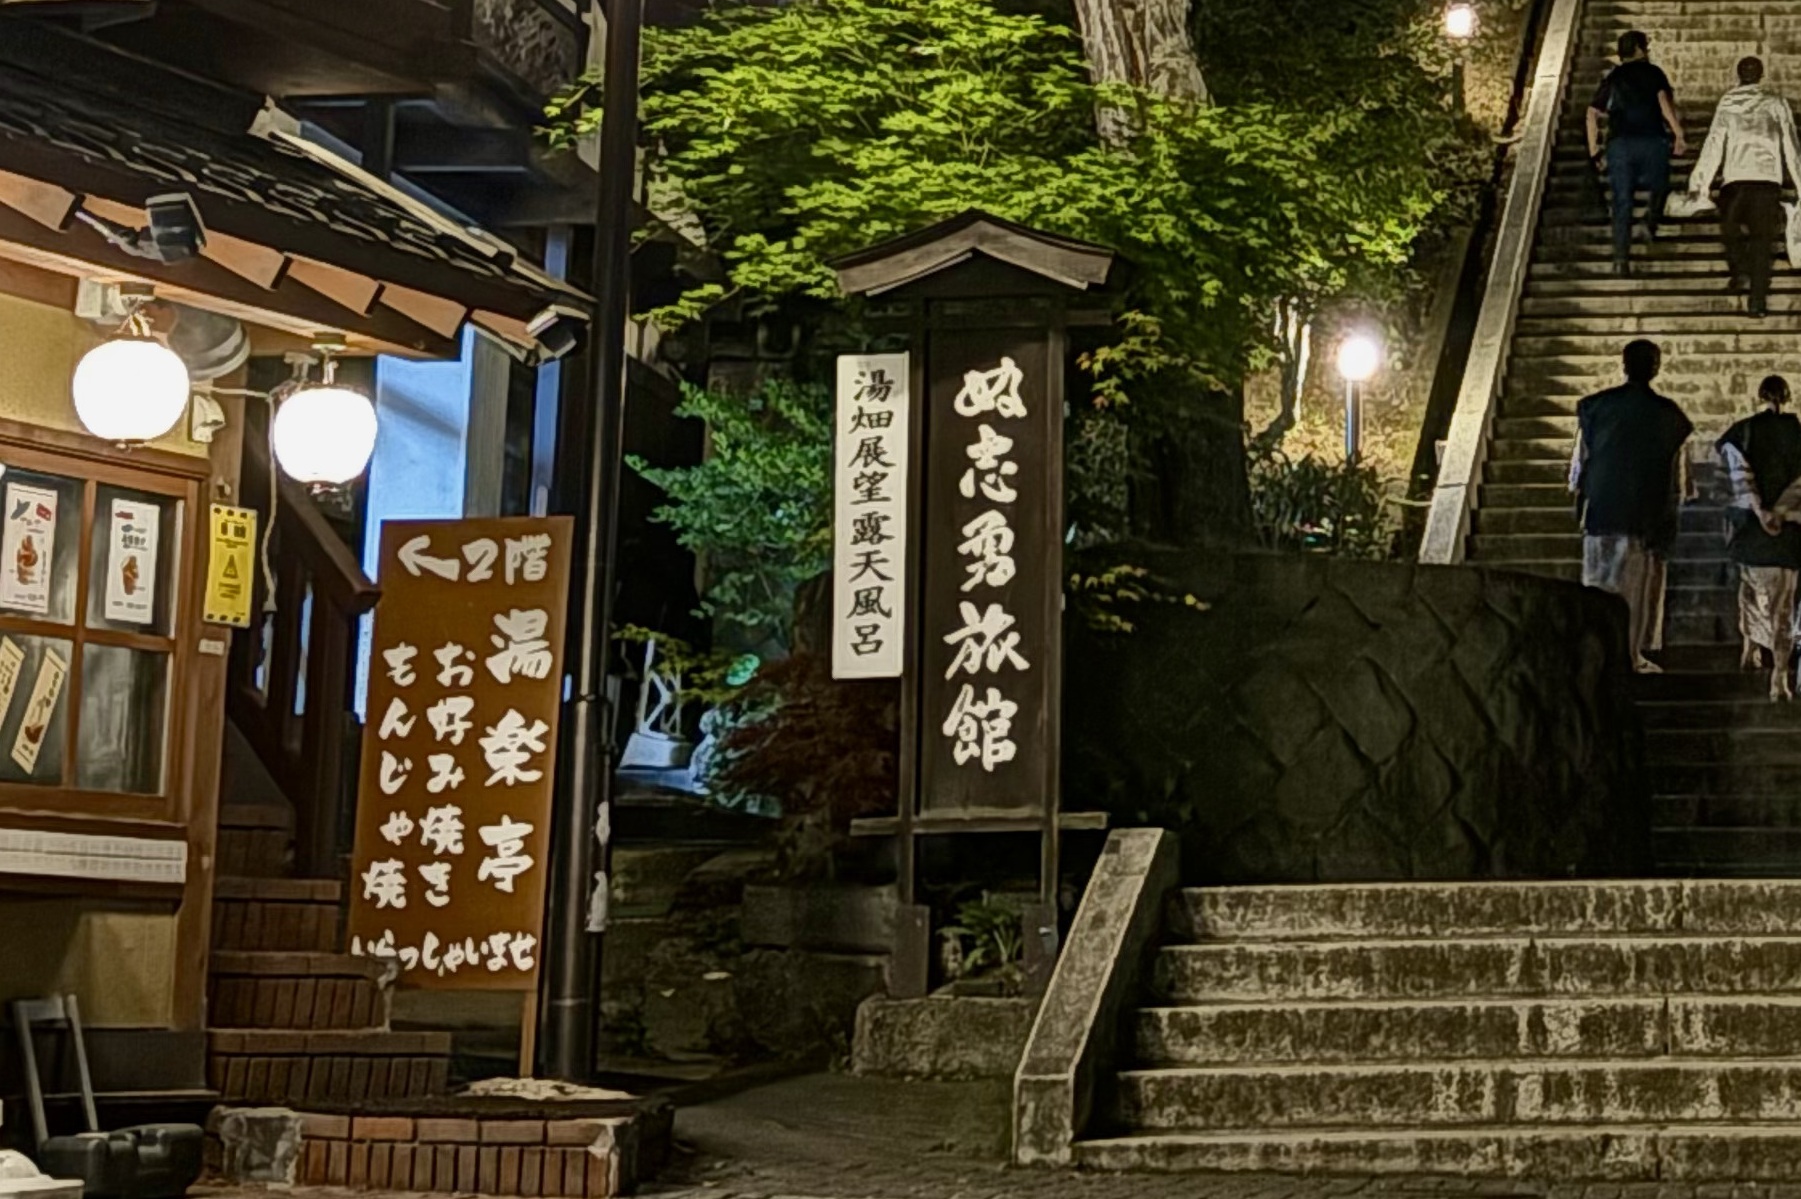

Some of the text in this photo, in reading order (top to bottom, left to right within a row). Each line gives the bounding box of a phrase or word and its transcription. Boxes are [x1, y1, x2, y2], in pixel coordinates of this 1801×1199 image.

[462, 533, 553, 586] 2階
[846, 368, 896, 658] 湯畑展望露天風呂
[942, 356, 1030, 773] ぬ志勇旅館
[361, 641, 418, 910] もんじゃ焼
[418, 641, 477, 908] お好み焼き
[477, 607, 554, 894] 湯楽亭
[350, 928, 538, 978] いらっしゃいませ
